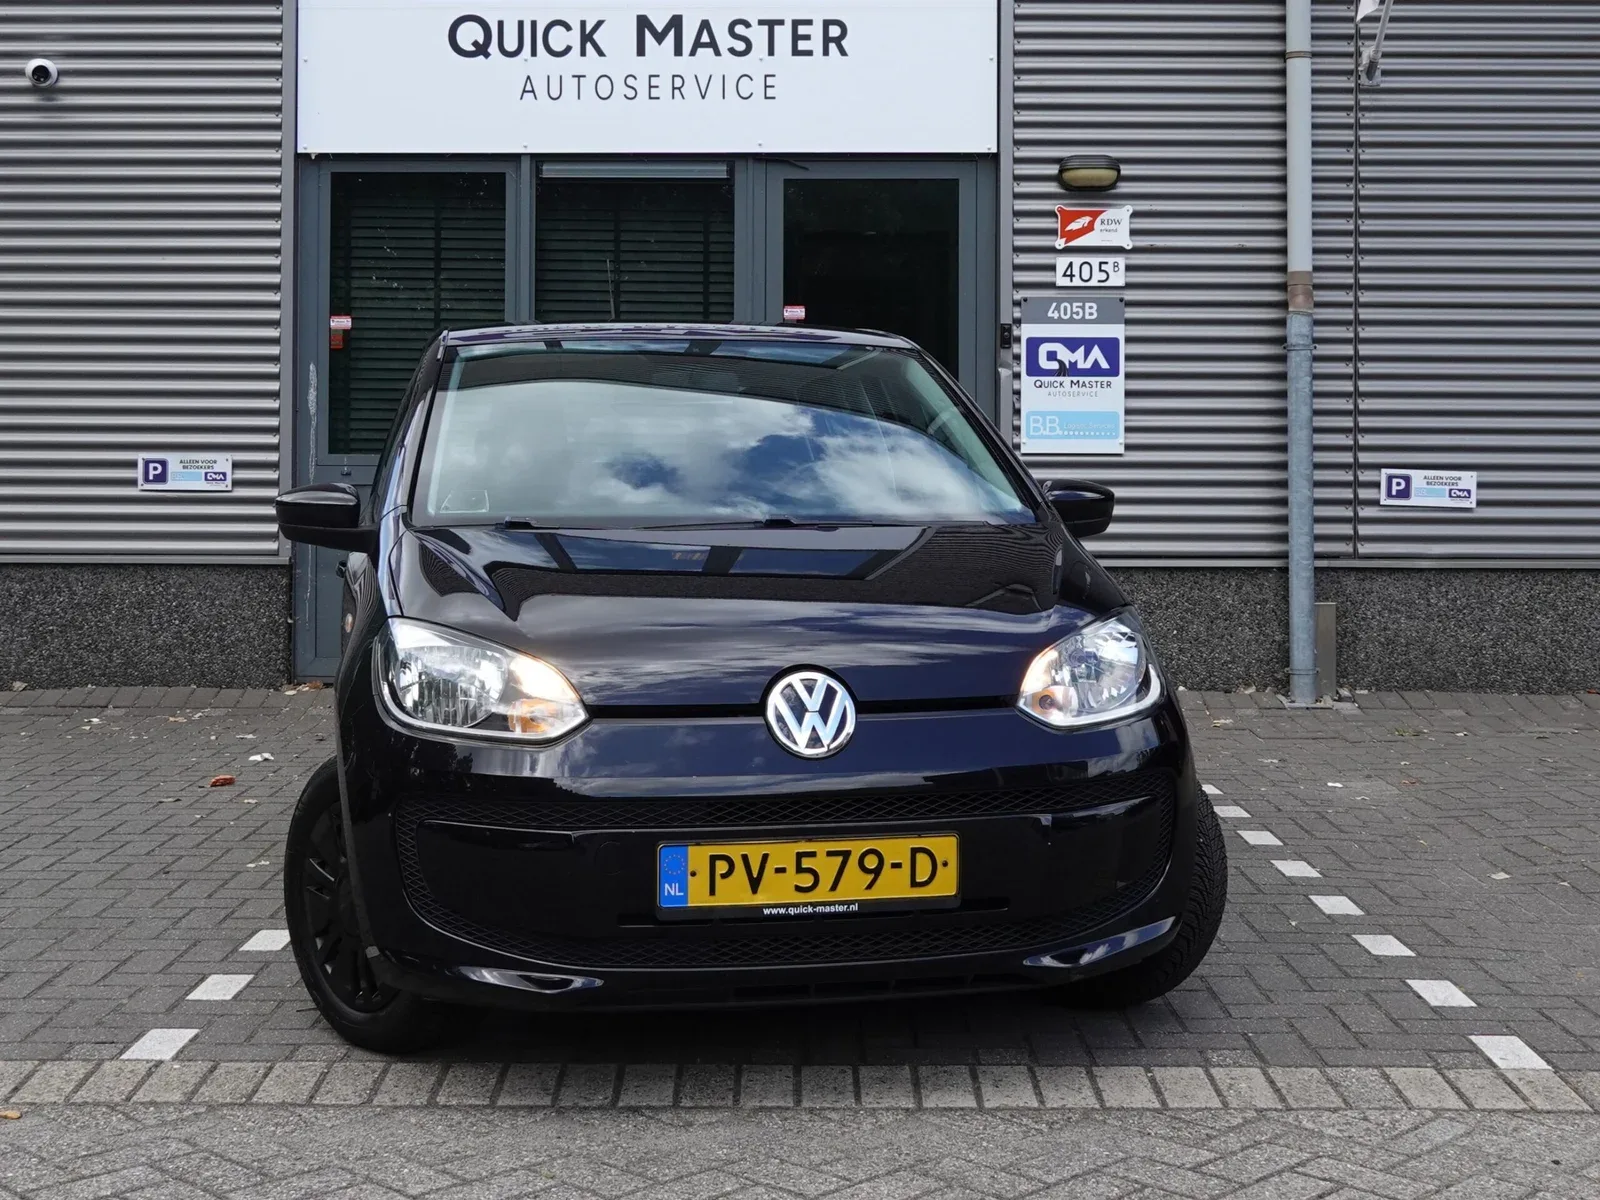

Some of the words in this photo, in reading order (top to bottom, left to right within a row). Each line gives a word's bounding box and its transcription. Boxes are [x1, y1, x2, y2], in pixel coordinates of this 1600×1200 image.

[519, 73, 778, 101] AUTOSERVICE
[1100, 218, 1123, 226] RDW
[1047, 302, 1098, 320] 405B
[148, 462, 163, 480] P
[1391, 478, 1406, 496] P
[664, 882, 684, 896] NL
[708, 845, 938, 897] PV-579-D
[763, 902, 859, 916] www.quick-master.nl
